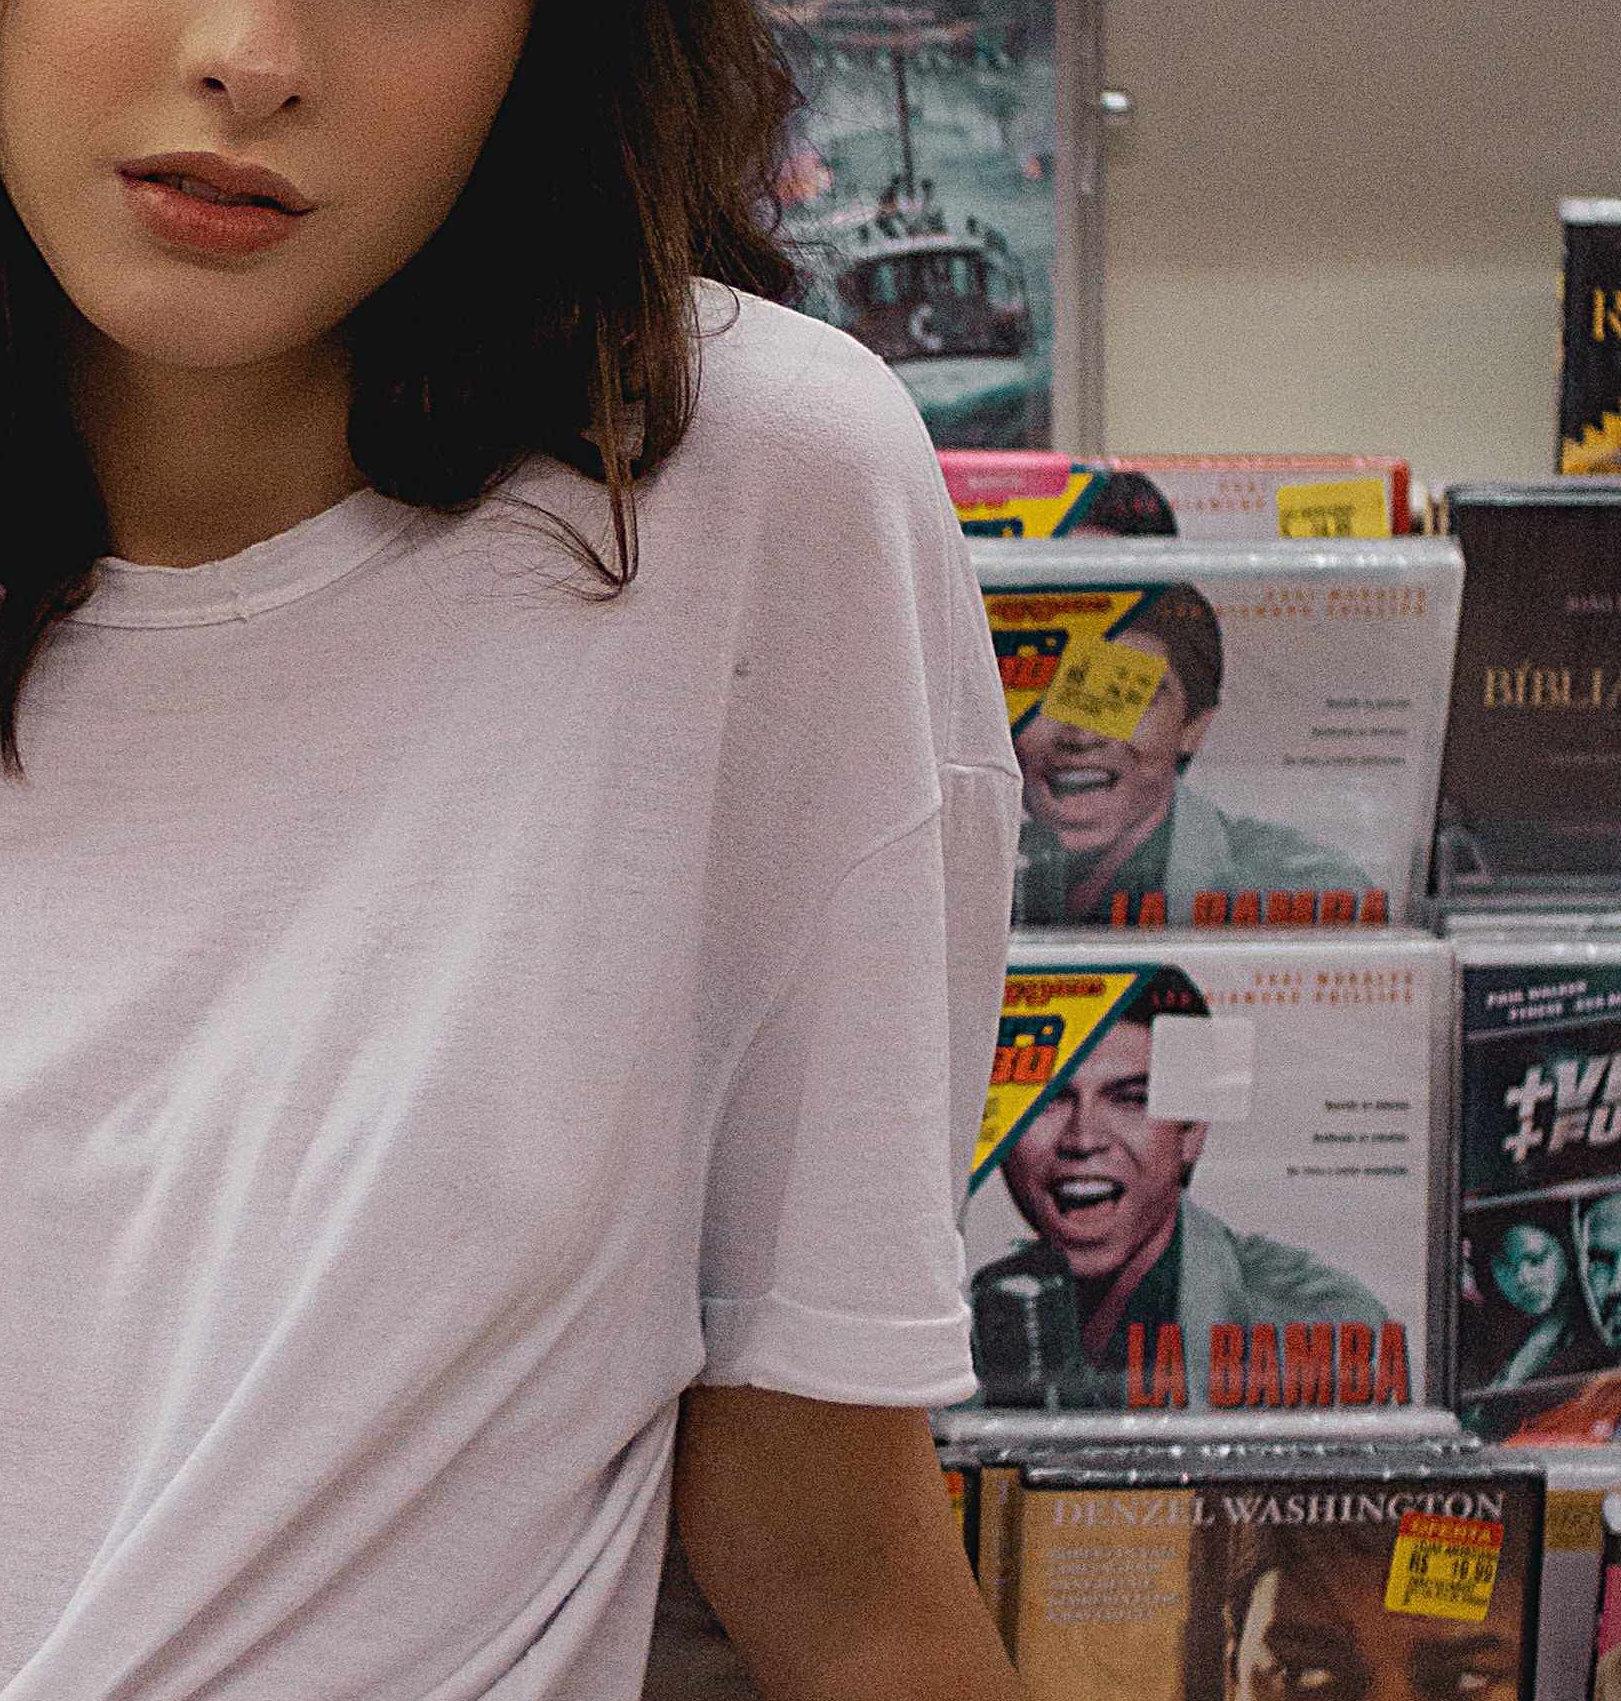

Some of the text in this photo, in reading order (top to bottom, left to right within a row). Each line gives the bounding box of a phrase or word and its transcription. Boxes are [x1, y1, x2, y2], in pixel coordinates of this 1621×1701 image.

[1127, 1321, 1410, 1407] LA BAMBA
[1052, 1491, 1505, 1530] DENZEL WASHINGTON
[1410, 1520, 1493, 1543] OFERTA
